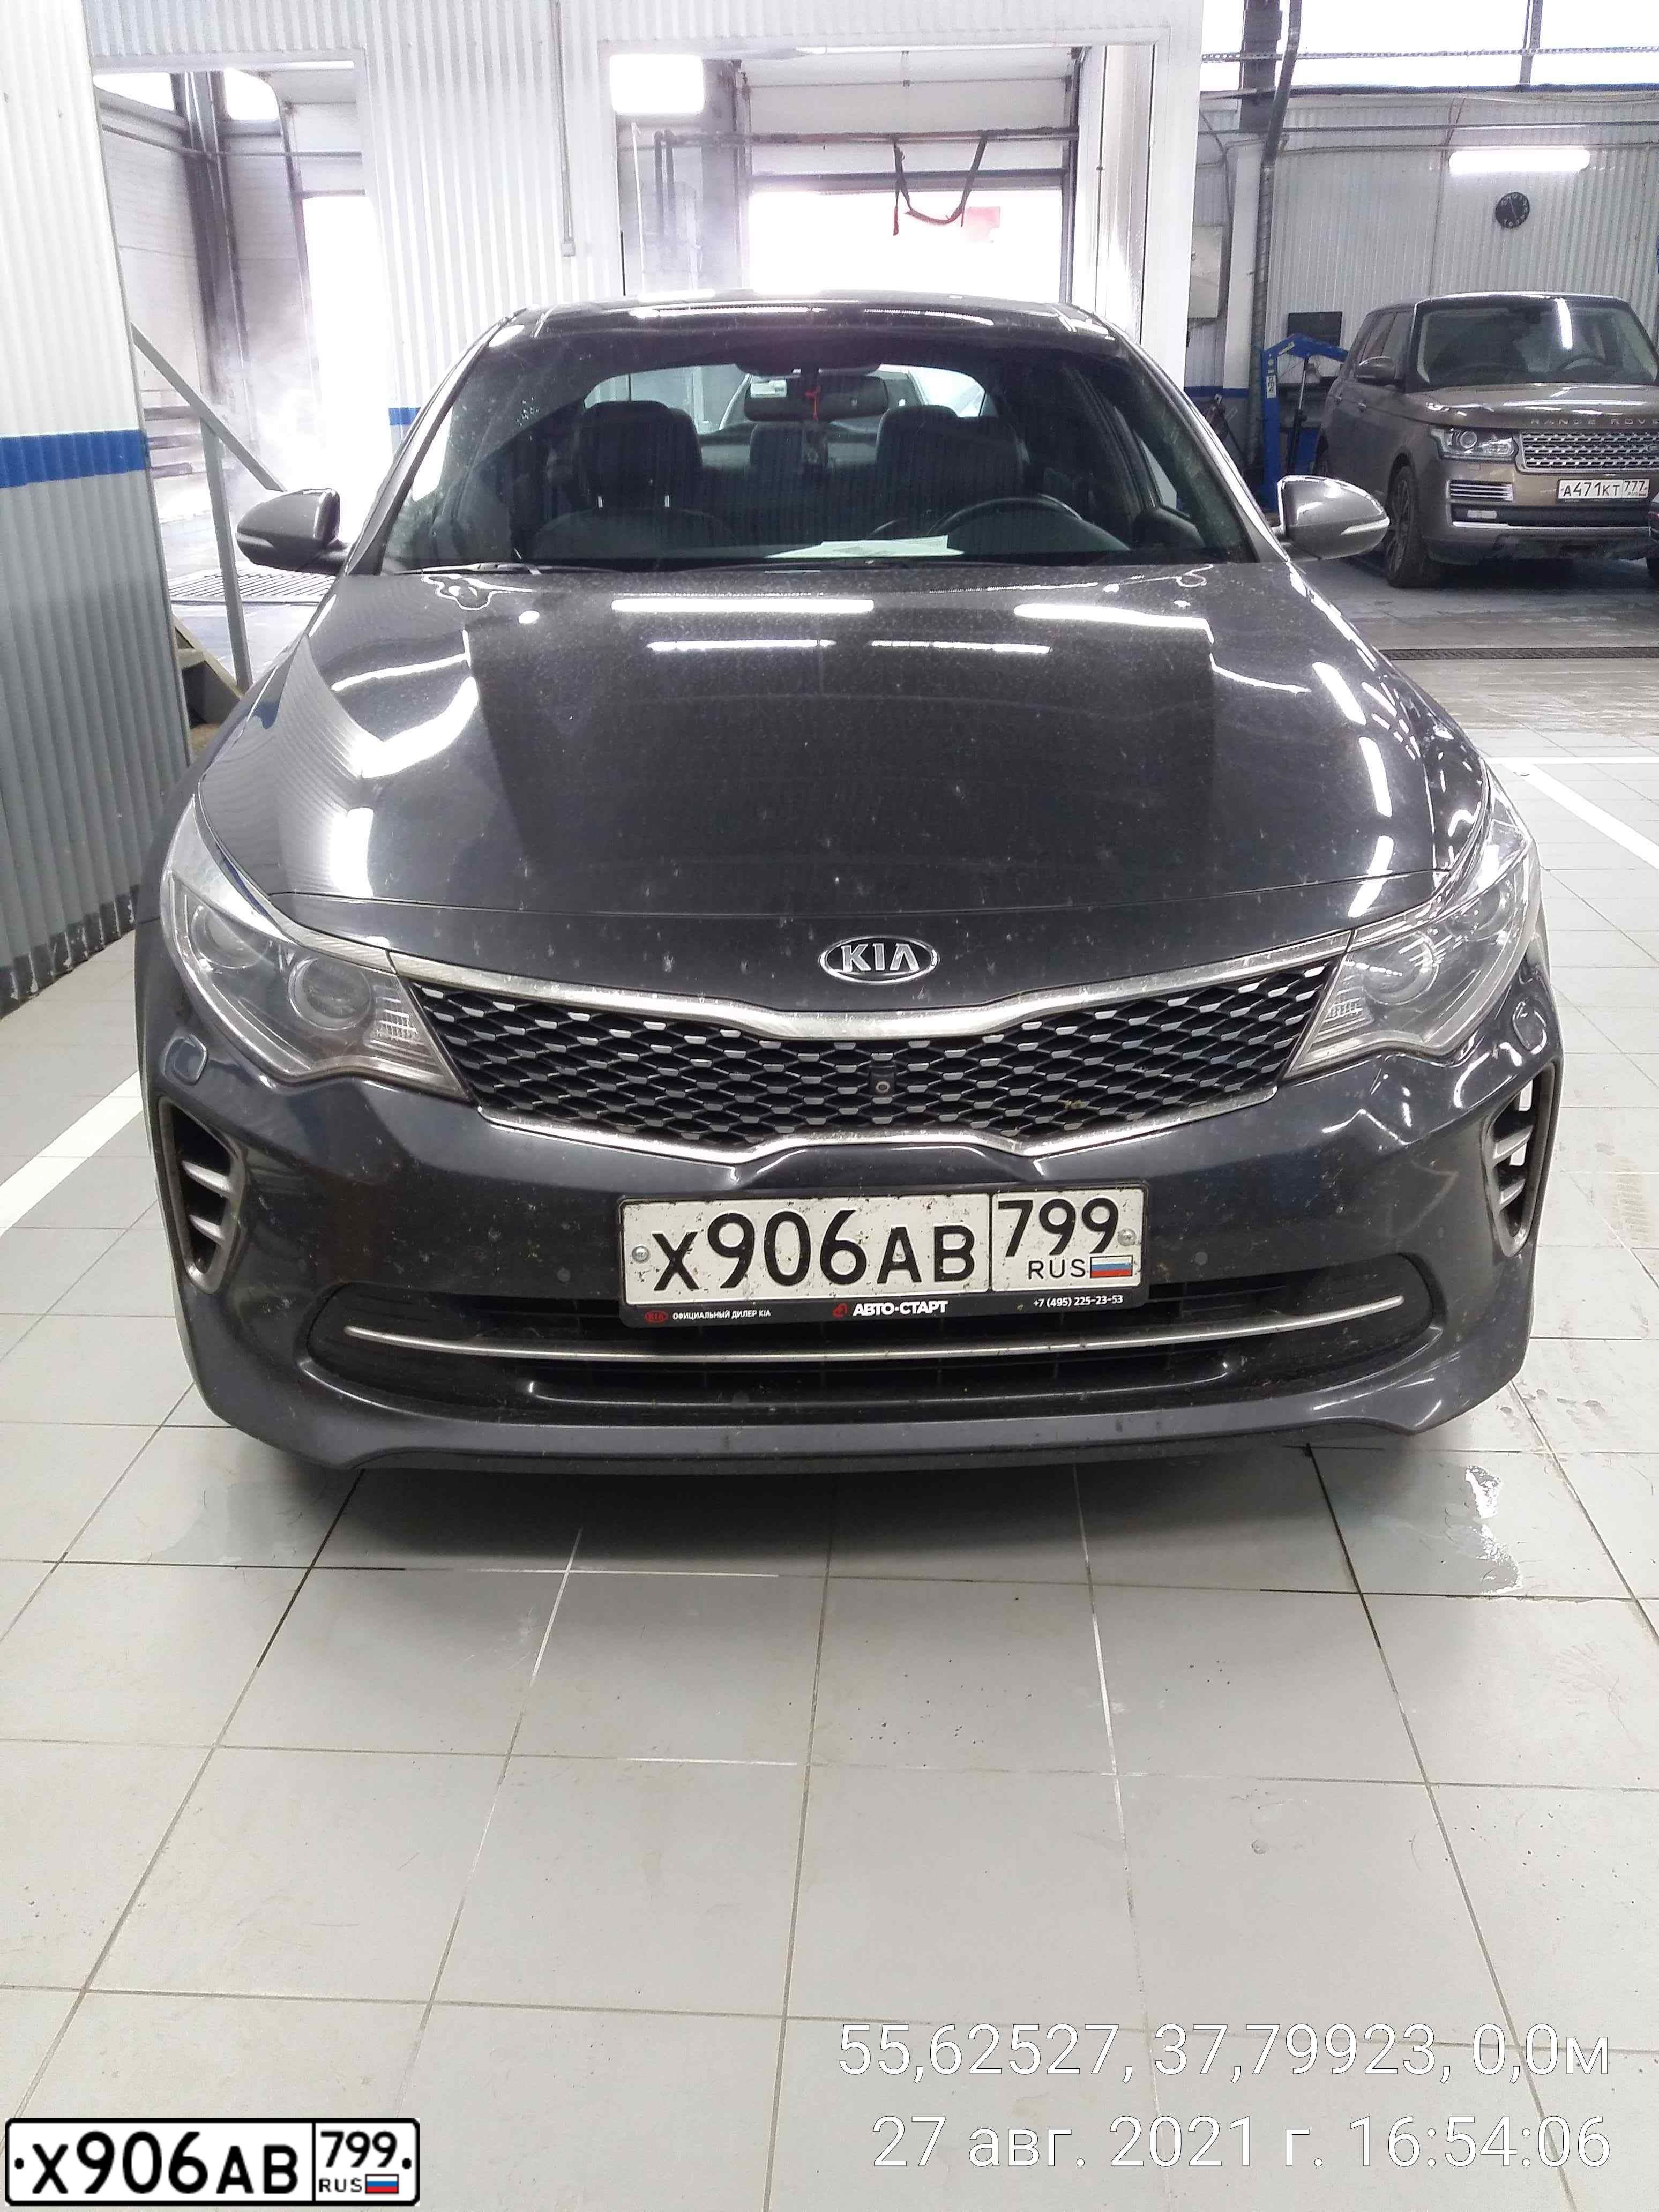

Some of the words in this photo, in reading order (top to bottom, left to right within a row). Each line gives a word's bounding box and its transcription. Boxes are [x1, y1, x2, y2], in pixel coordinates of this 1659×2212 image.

[1563, 482, 1620, 497] А471КТ
[1624, 480, 1645, 492] 777
[840, 943, 920, 973] KIA
[652, 1210, 975, 1291] Х906АВ
[998, 1198, 1119, 1257] 799
[1028, 1259, 1086, 1280] RUS
[853, 1301, 948, 1316] АВТО-СТАРТ
[1033, 1298, 1045, 1307] +7
[1046, 1297, 1072, 1308] (495)
[1074, 1295, 1123, 1306] 225-23-53
[672, 1310, 730, 1320] ОФИЦИАЛЬНЫЙ
[731, 1310, 757, 1319] ДИЛЕР
